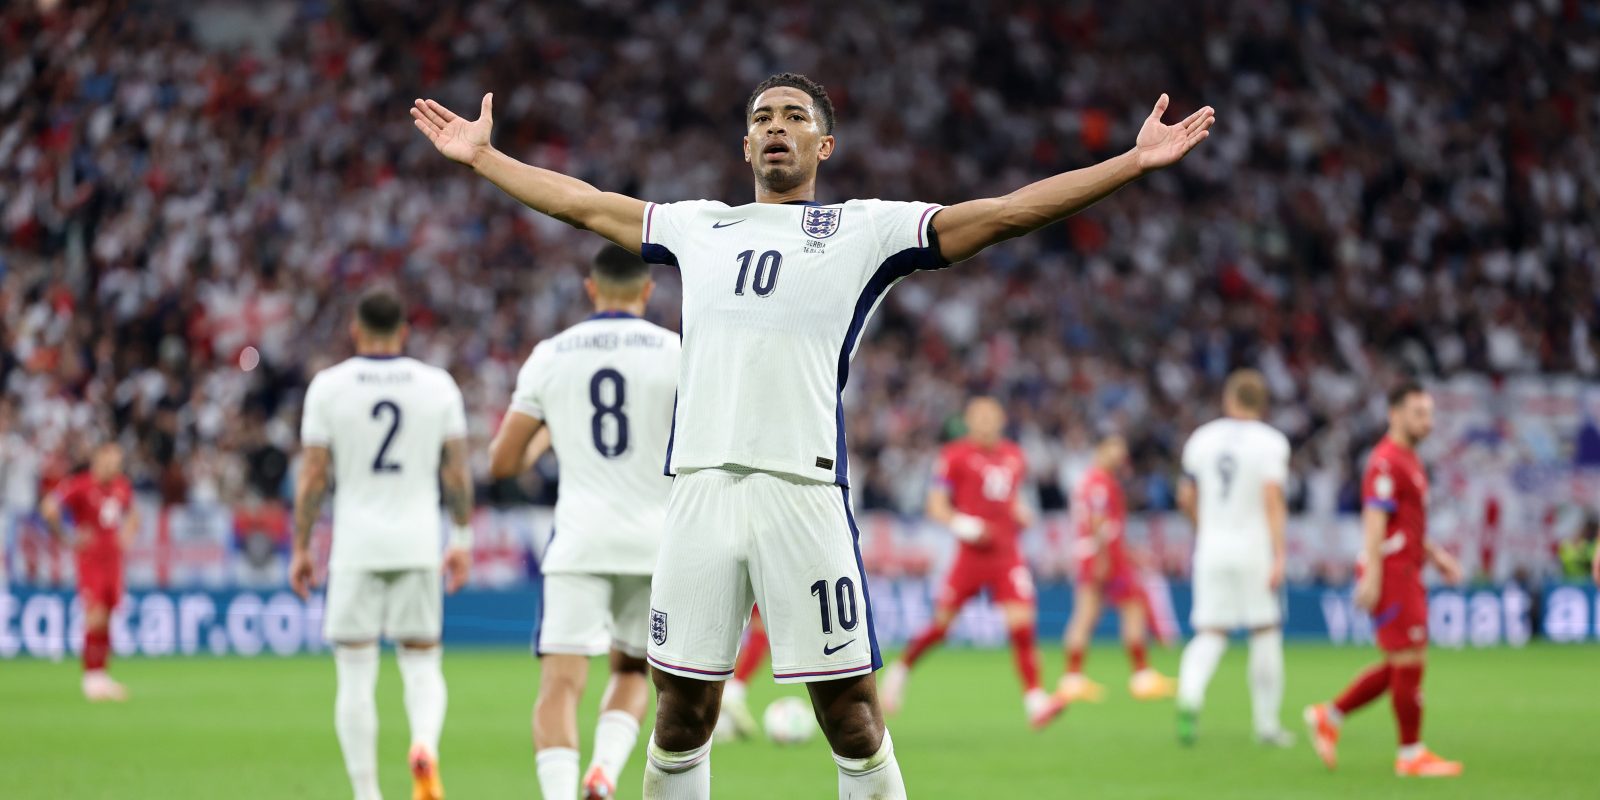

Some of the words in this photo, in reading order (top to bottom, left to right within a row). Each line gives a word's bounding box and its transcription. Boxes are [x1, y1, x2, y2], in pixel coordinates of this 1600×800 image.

[806, 239, 826, 249] SERBIA
[735, 249, 783, 298] 10
[371, 400, 402, 472] 2
[589, 366, 628, 458] 8
[1216, 451, 1239, 504] 9
[810, 576, 859, 634] 10
